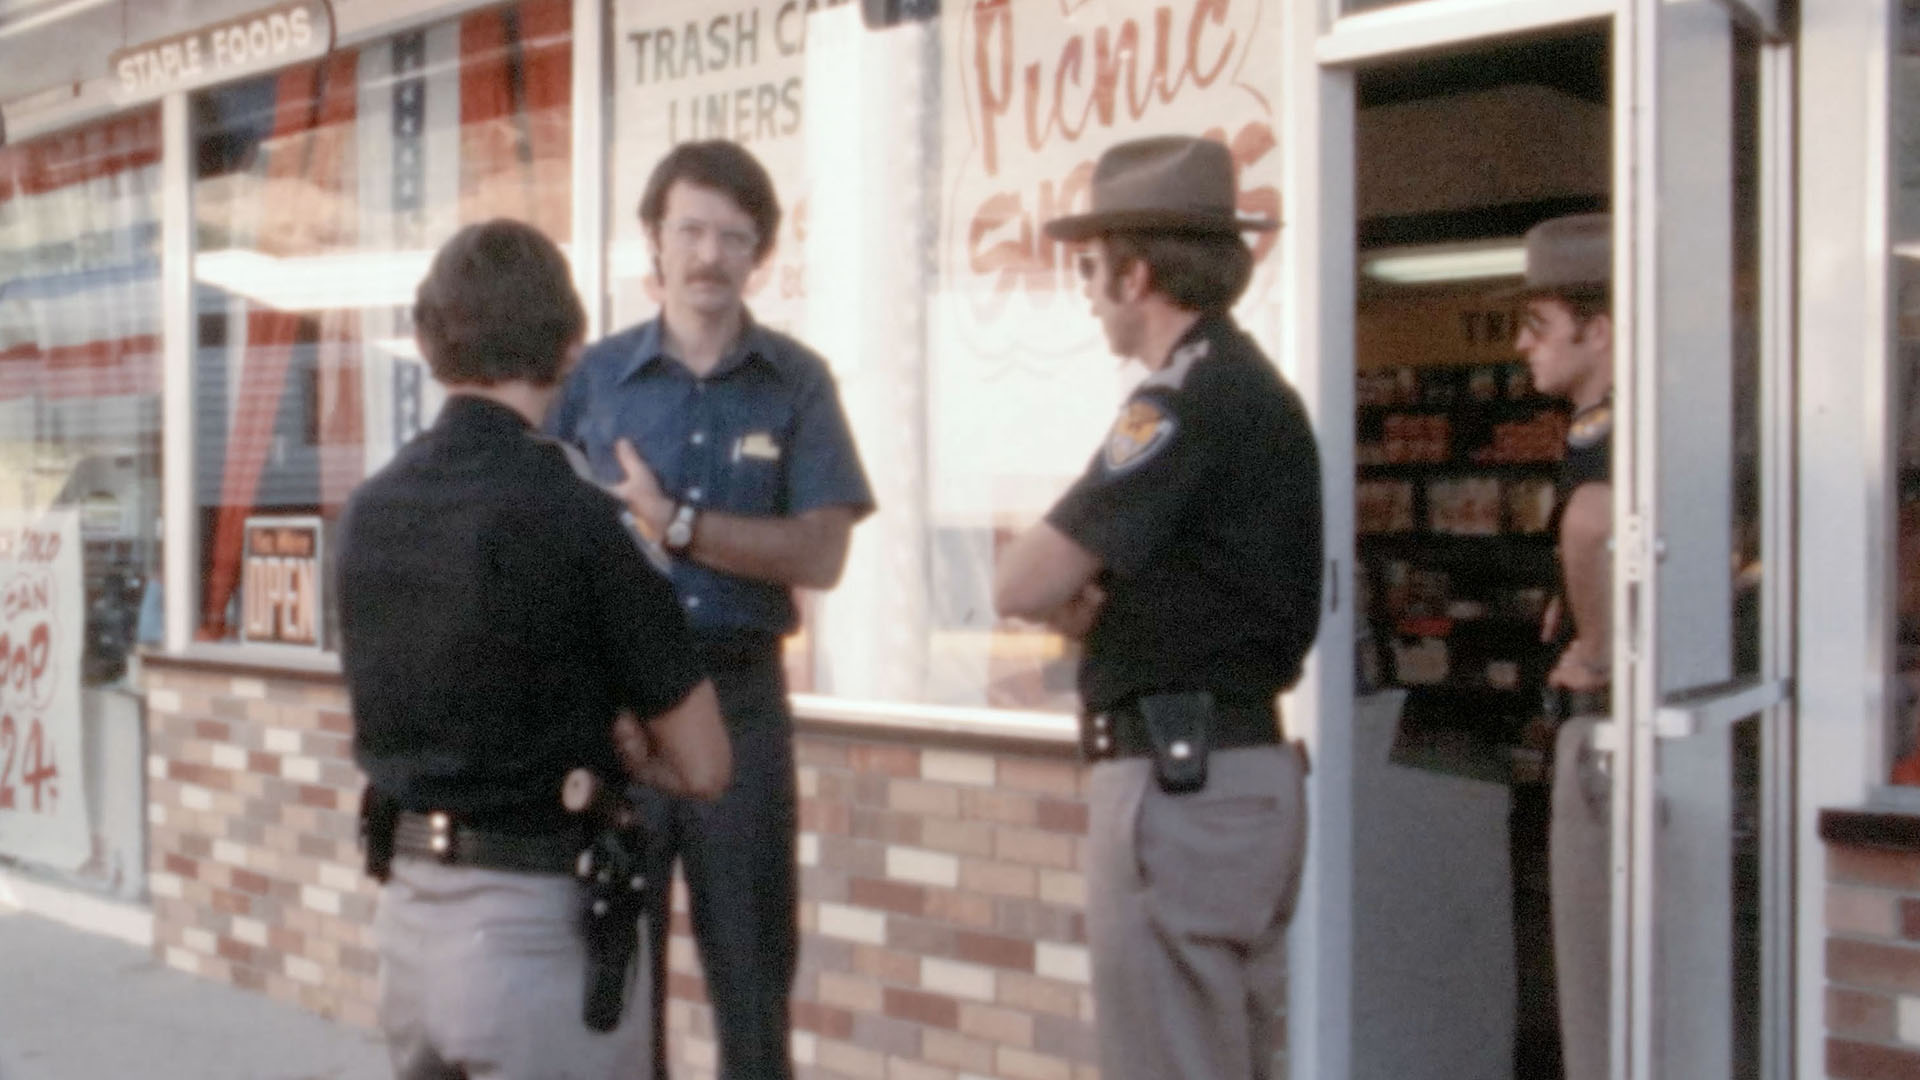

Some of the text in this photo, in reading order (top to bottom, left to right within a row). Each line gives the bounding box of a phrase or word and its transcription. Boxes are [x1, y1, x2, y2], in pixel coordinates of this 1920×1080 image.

[117, 6, 313, 93] STAPLE FOODS
[627, 8, 759, 85] TRASH
[668, 77, 804, 147] LINERS
[245, 557, 318, 638] OPEN
